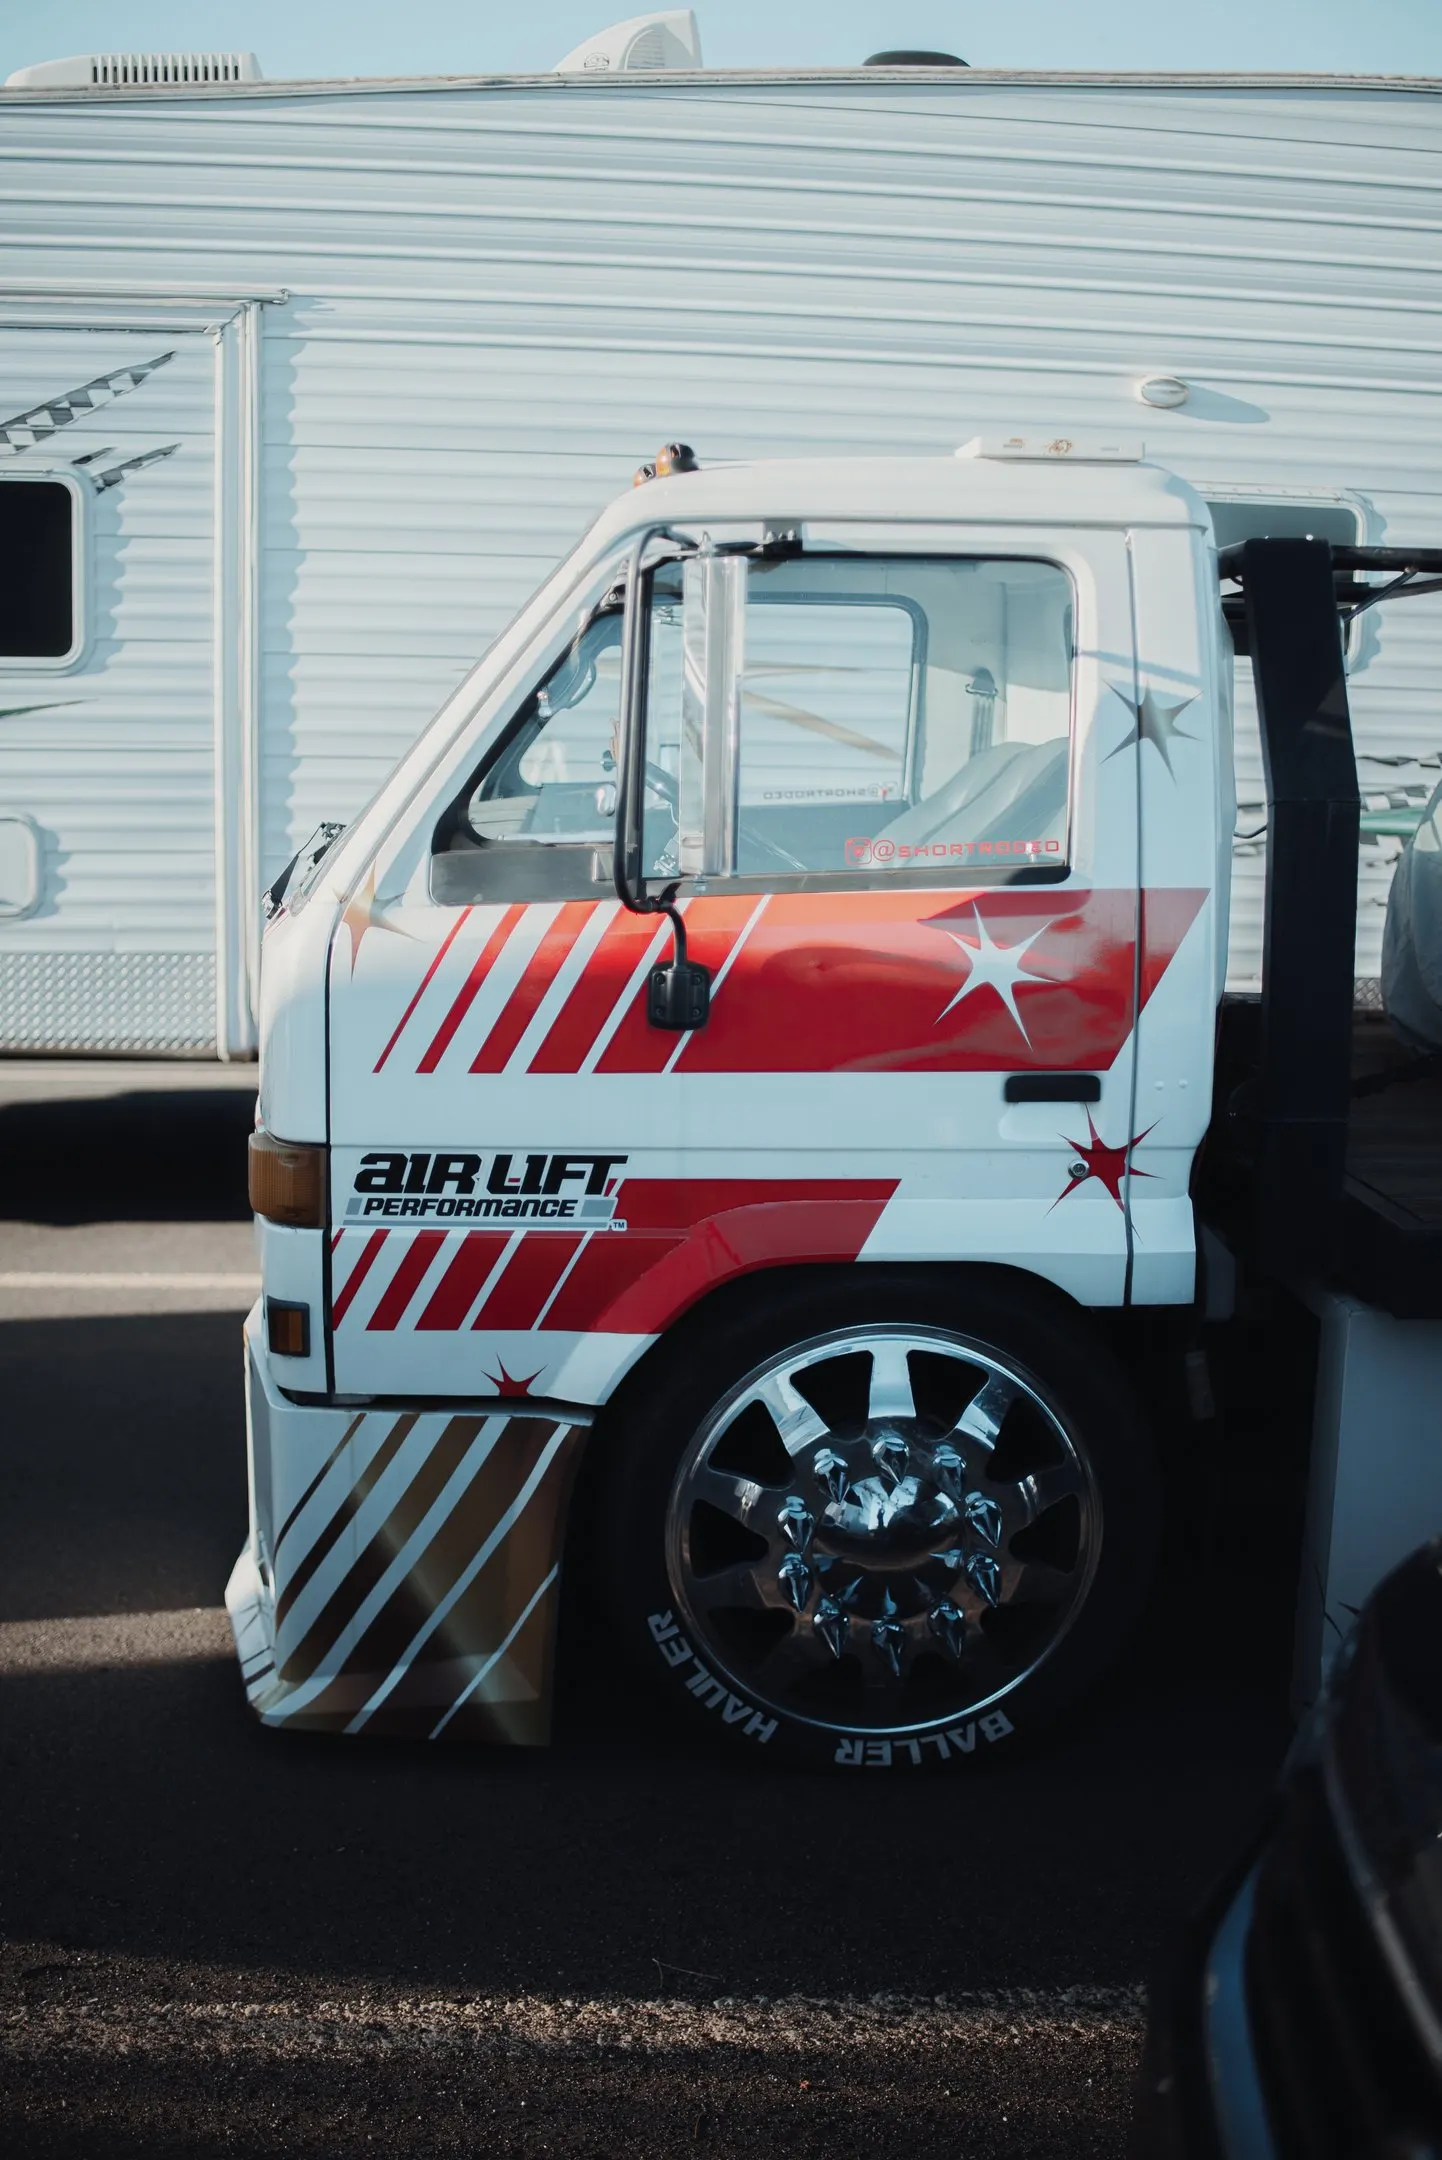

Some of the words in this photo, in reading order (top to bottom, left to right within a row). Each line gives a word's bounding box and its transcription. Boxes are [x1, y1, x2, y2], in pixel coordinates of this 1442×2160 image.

[486, 1153, 629, 1196] LIFT
[646, 1608, 780, 1745] HAULER
[833, 1708, 1016, 1767] BALLER
